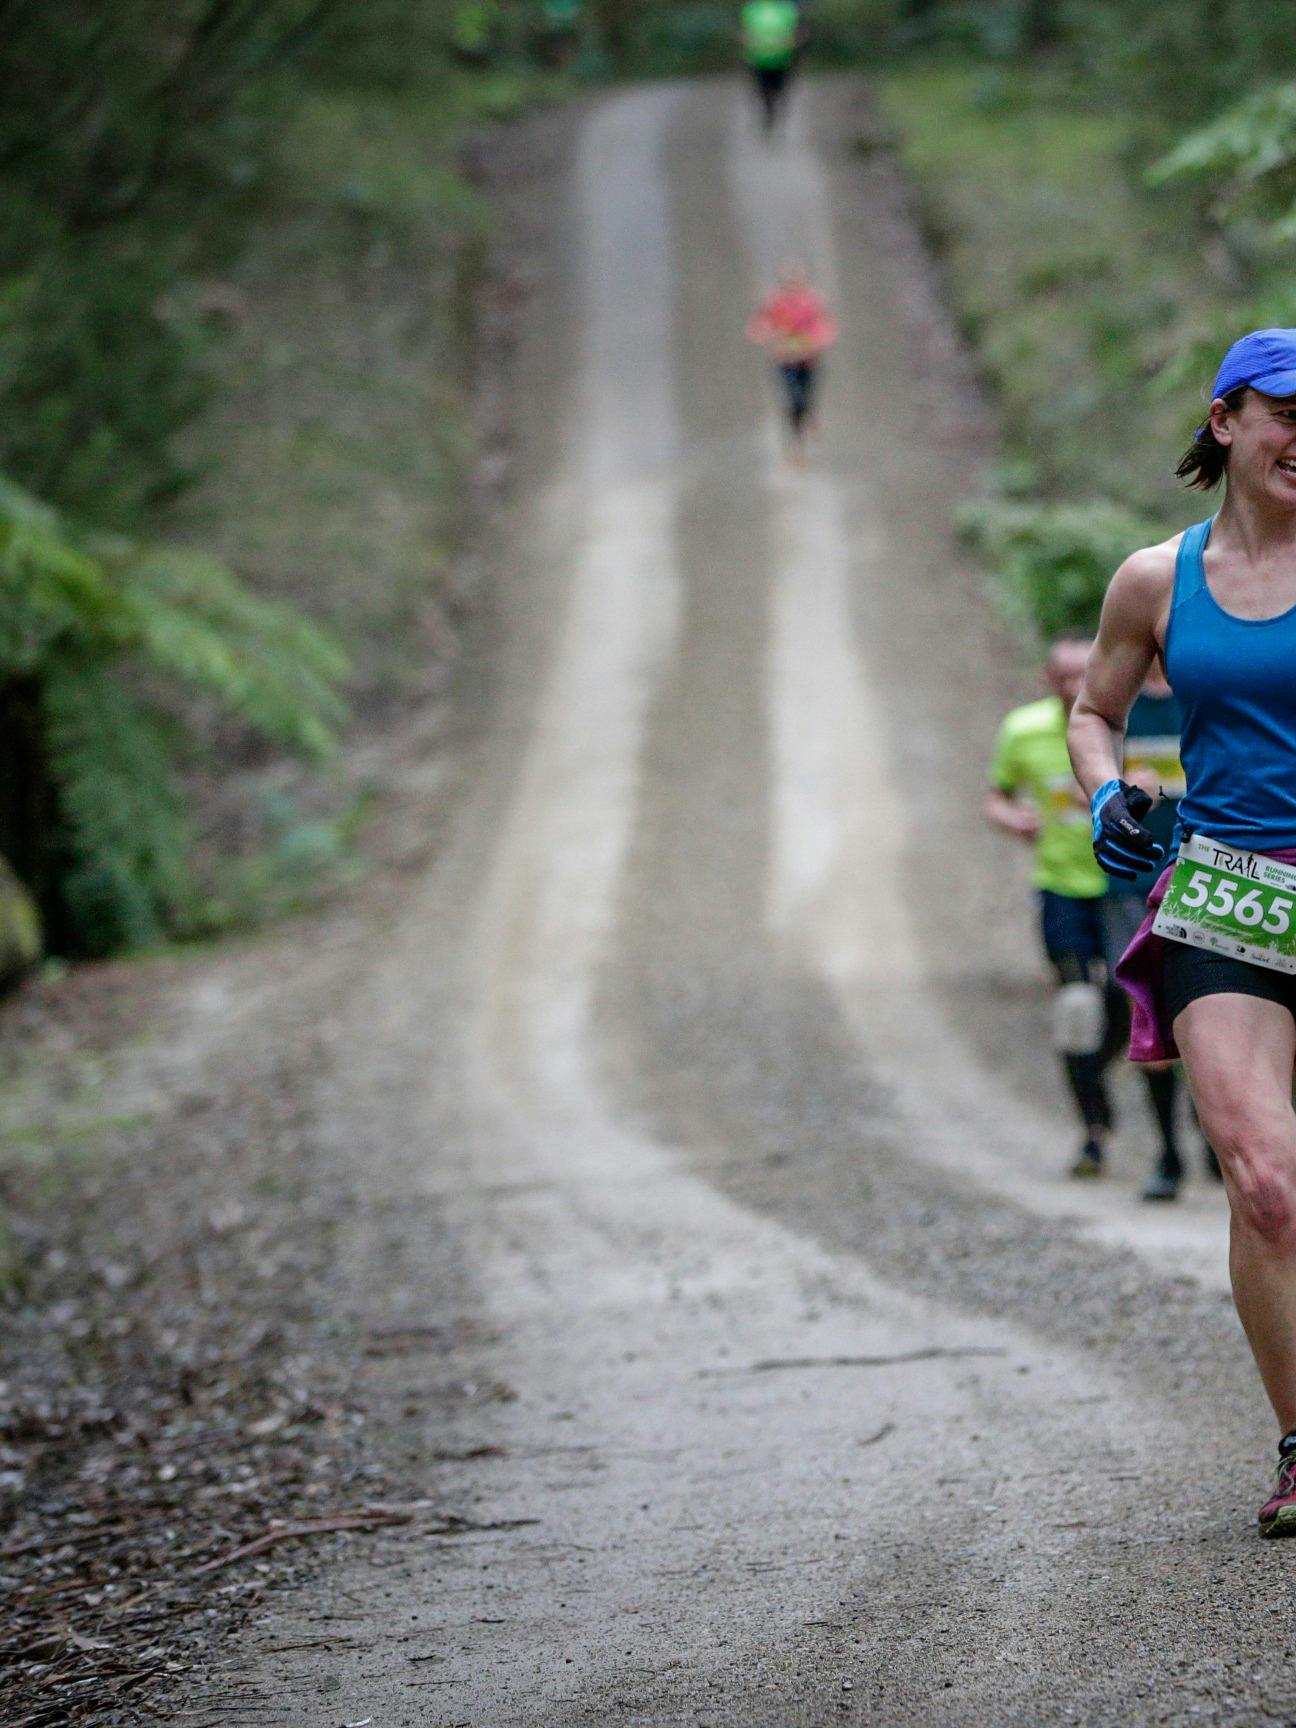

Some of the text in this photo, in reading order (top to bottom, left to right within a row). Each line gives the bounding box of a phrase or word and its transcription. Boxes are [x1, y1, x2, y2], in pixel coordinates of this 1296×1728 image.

[1212, 848, 1260, 880] TRAIL
[1263, 871, 1286, 884] SERIES
[1180, 870, 1294, 935] 5565
